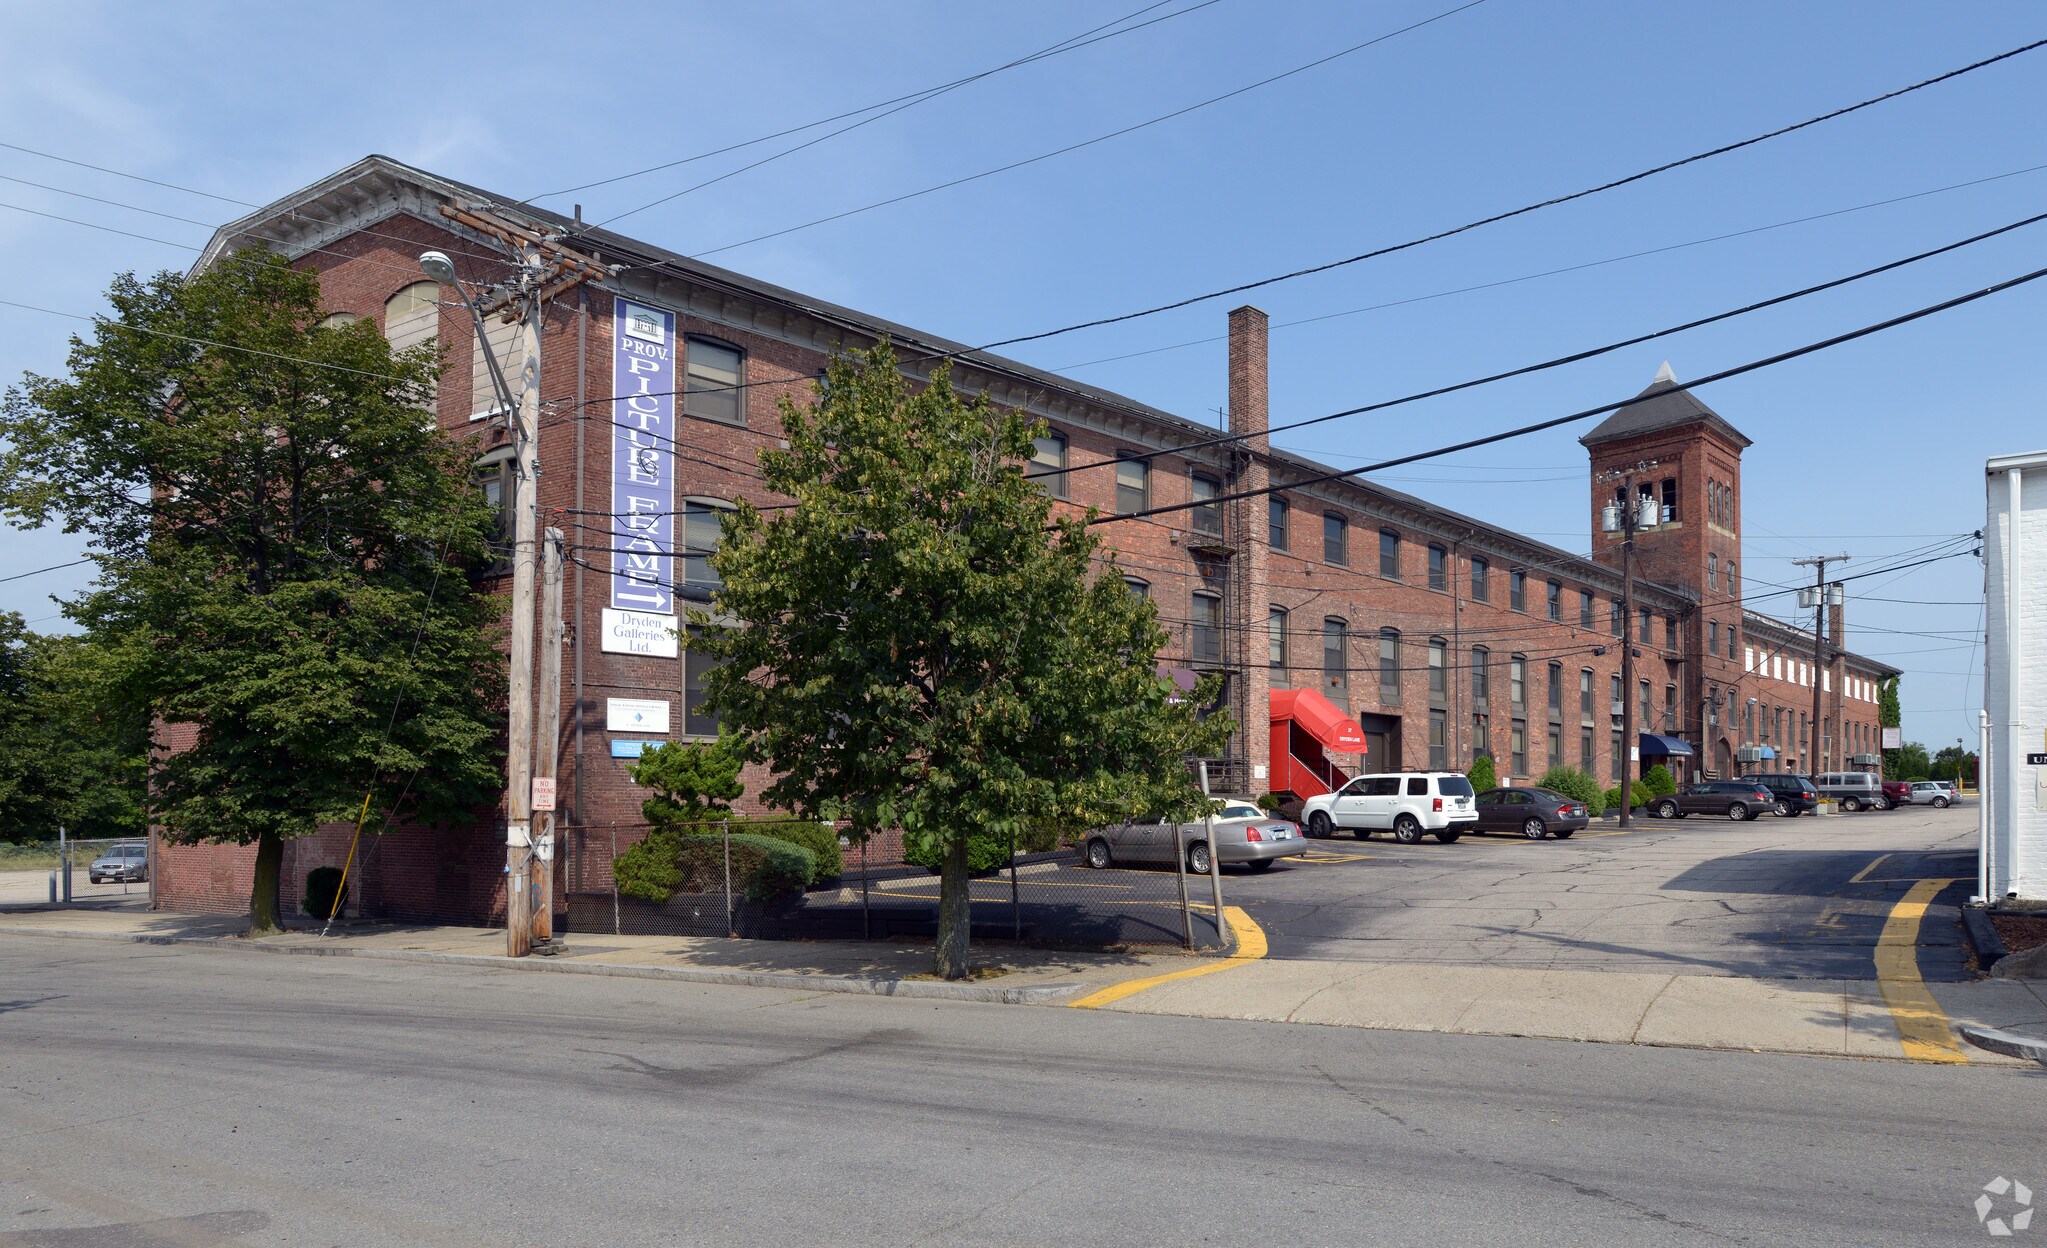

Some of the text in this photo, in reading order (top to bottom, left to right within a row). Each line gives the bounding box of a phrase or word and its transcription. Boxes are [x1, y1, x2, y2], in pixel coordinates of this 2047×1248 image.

[621, 337, 669, 361] PROV.
[627, 356, 660, 486] PICTURE
[625, 496, 661, 589] FRAME
[621, 613, 662, 632] Dryden
[613, 626, 665, 642] Galleries
[629, 640, 652, 653] Ltd.
